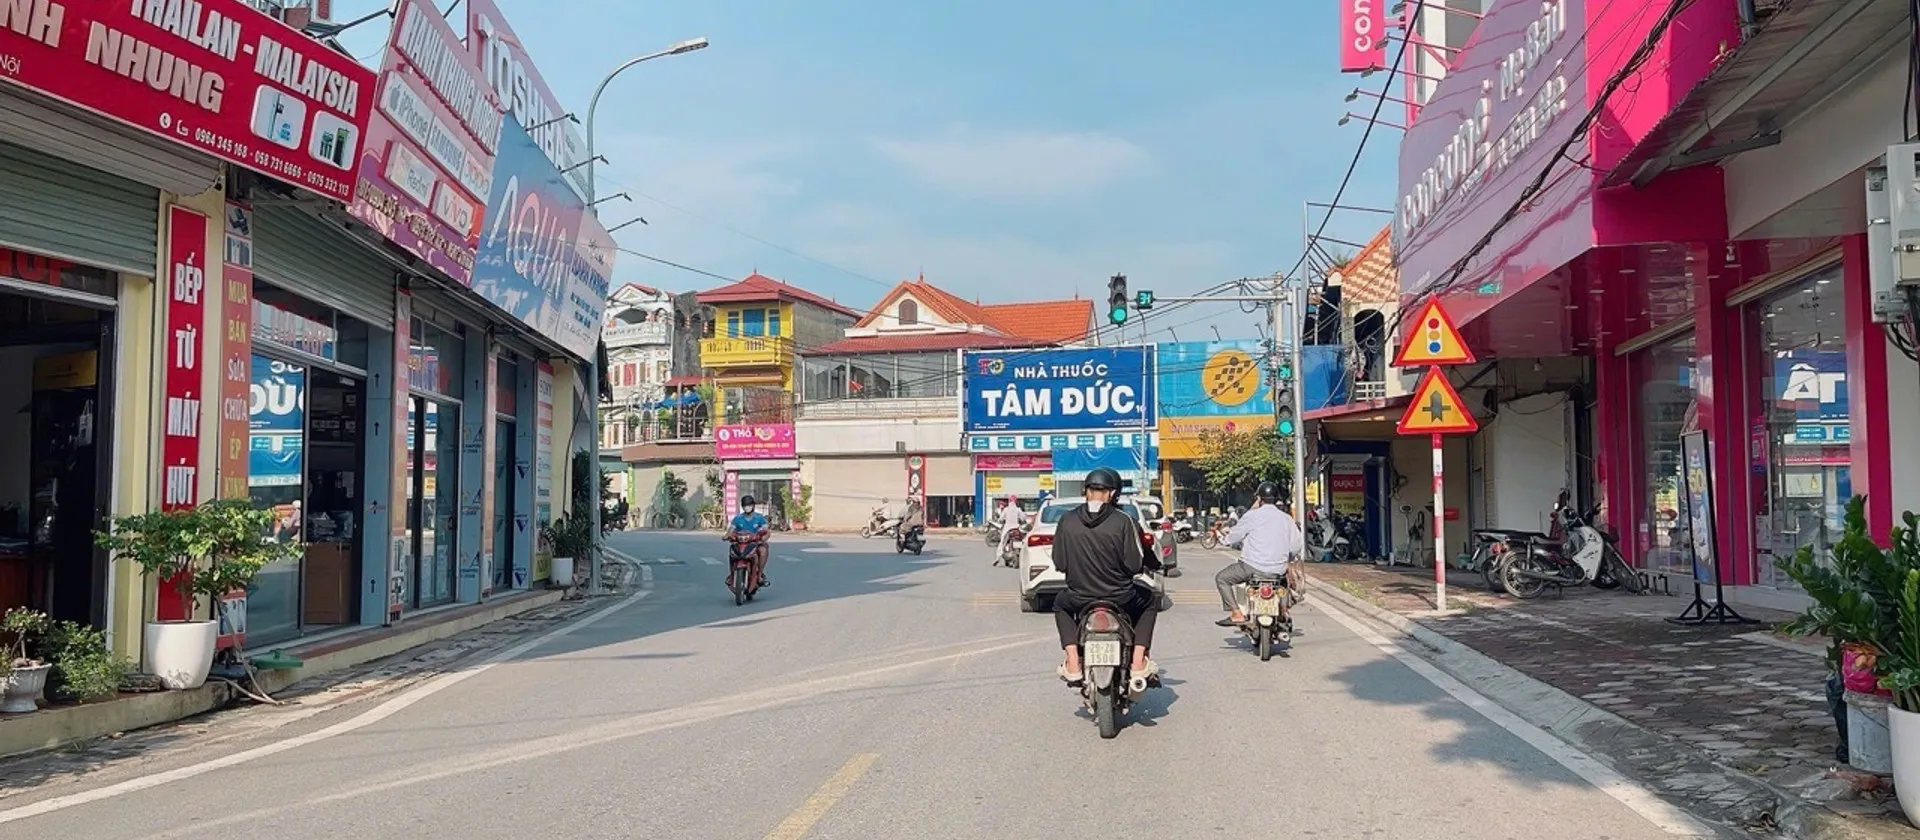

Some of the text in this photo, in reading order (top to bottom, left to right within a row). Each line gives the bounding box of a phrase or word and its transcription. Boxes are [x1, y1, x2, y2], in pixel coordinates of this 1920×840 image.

[85, 20, 225, 113] NHUNG
[255, 35, 359, 117] MALAYSIA
[228, 280, 247, 304] MUA
[228, 315, 246, 342] BÁN
[167, 252, 202, 504] BẾP TỪ MÁY HÚT
[1014, 359, 1108, 378] NHÀ THUỐC
[981, 384, 1051, 416] TÂM
[1060, 380, 1135, 415] ĐỨC
